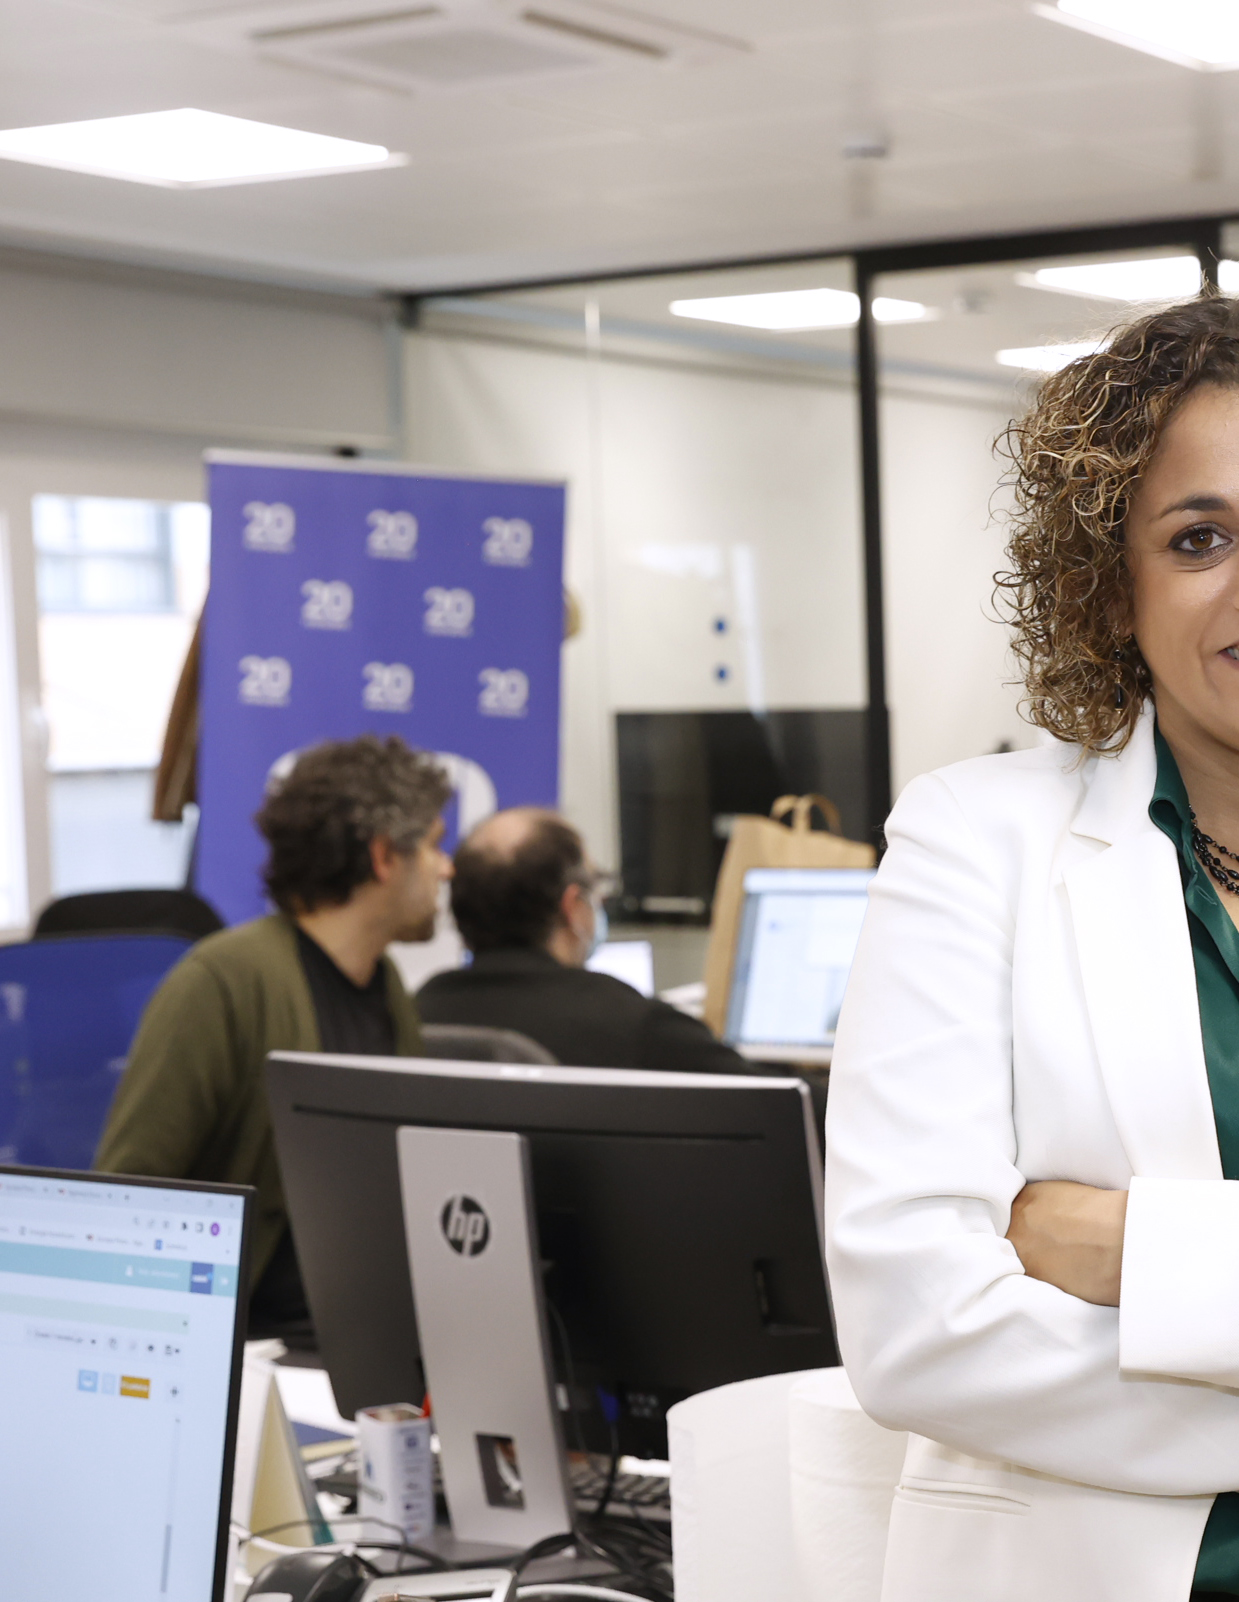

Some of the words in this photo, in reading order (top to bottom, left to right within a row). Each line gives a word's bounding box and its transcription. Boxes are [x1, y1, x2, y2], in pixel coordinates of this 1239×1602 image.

[243, 500, 296, 544] 20
[367, 509, 418, 552] 20
[483, 517, 533, 559] 20
[302, 579, 353, 623] 20
[424, 587, 475, 630] 20
[239, 654, 292, 698] 20
[363, 662, 414, 705] 20
[479, 668, 529, 711] 20
[442, 1195, 490, 1257] hp
